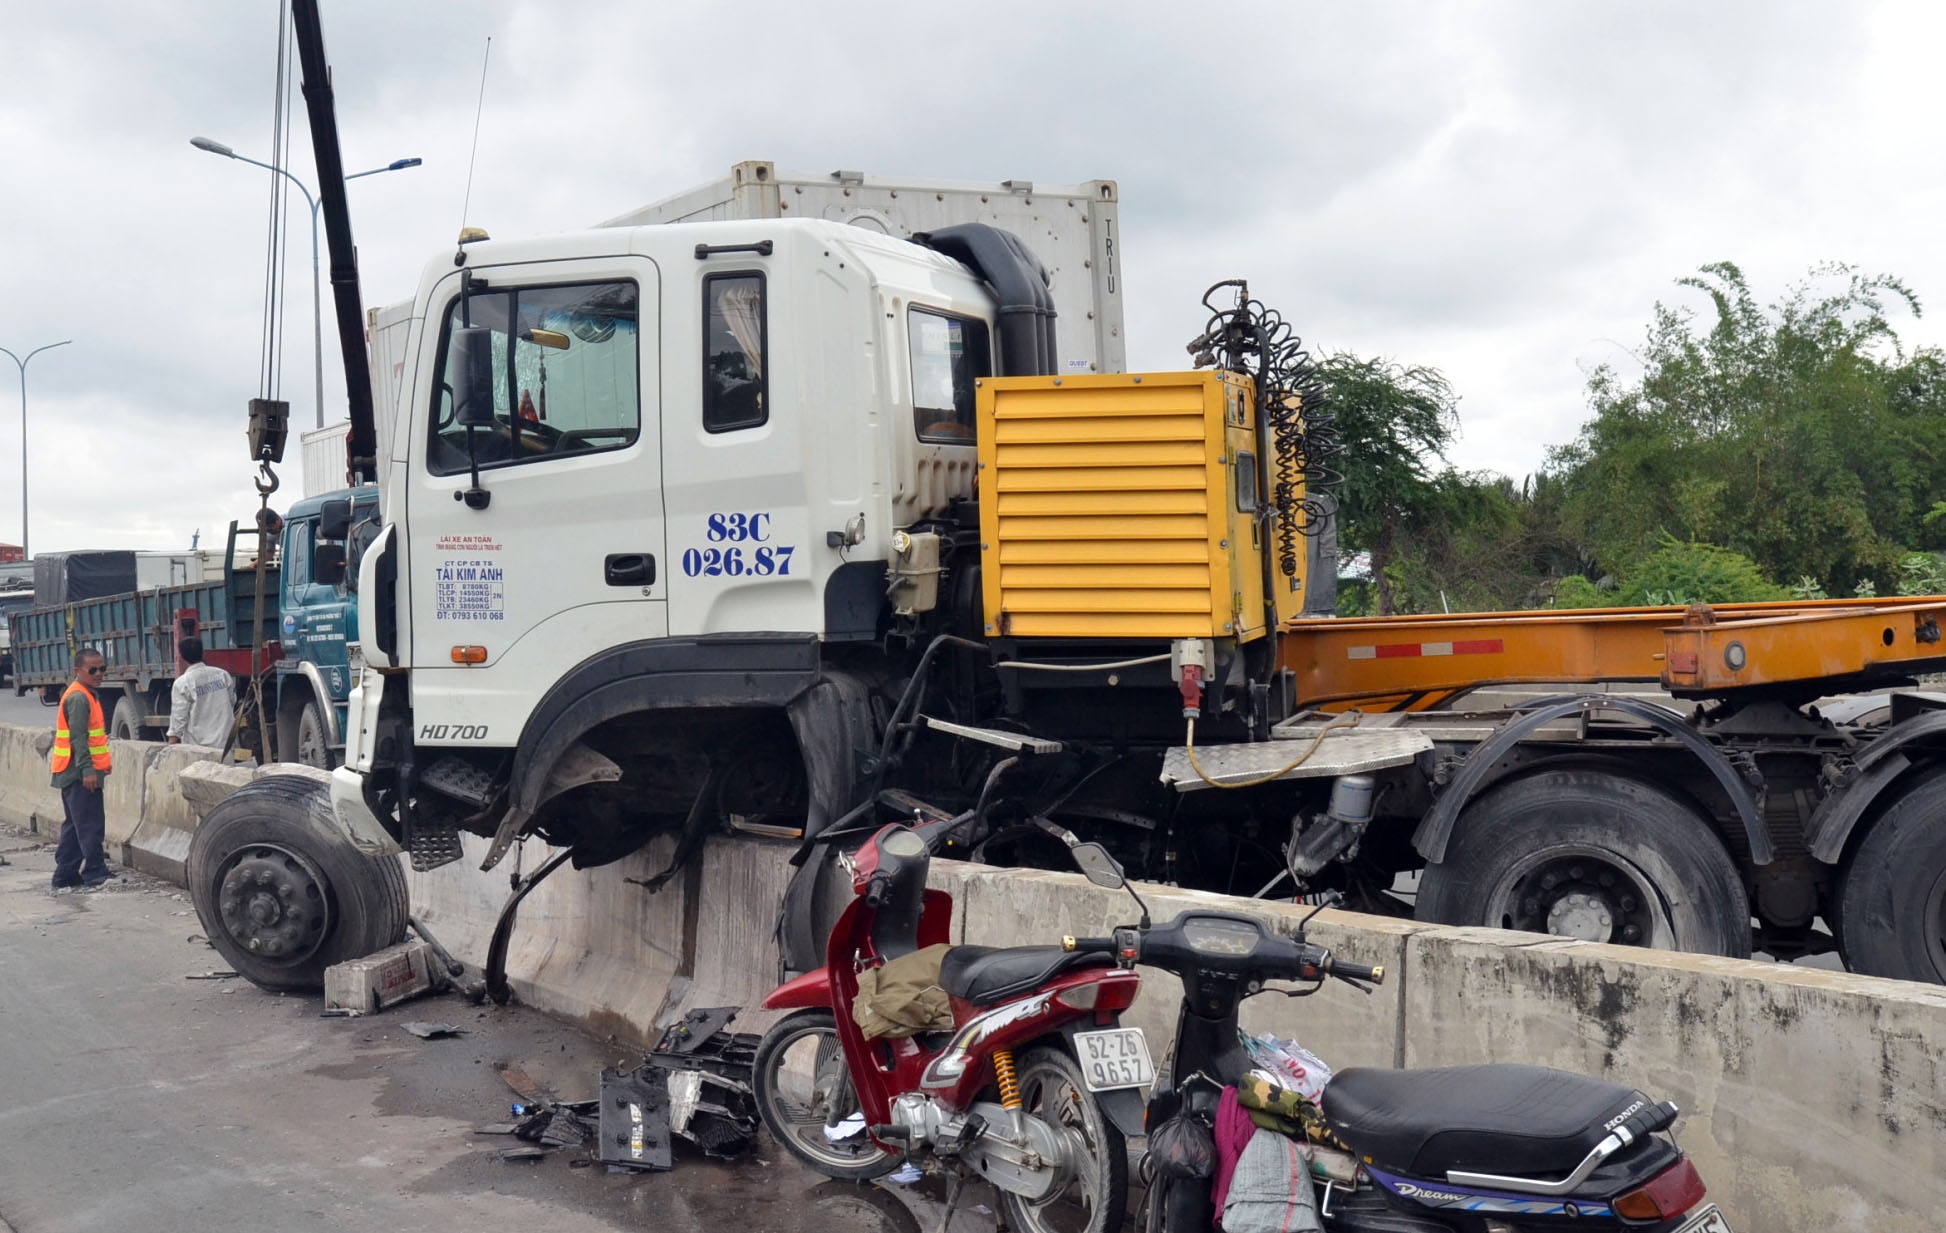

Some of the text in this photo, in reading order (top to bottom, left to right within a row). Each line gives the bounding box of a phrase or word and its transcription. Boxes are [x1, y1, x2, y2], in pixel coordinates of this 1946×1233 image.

[1105, 219, 1115, 294] TRIU
[707, 512, 770, 542] 83C
[456, 568, 476, 580] KIM
[480, 568, 503, 580] ANH
[682, 545, 795, 577] 026.87
[451, 612, 471, 620] 0793
[473, 612, 488, 620] 610
[489, 612, 504, 620] 068
[1093, 1058, 1143, 1084] 9657
[1603, 1100, 1645, 1131] HONDA
[1393, 1182, 1466, 1201] Dream
